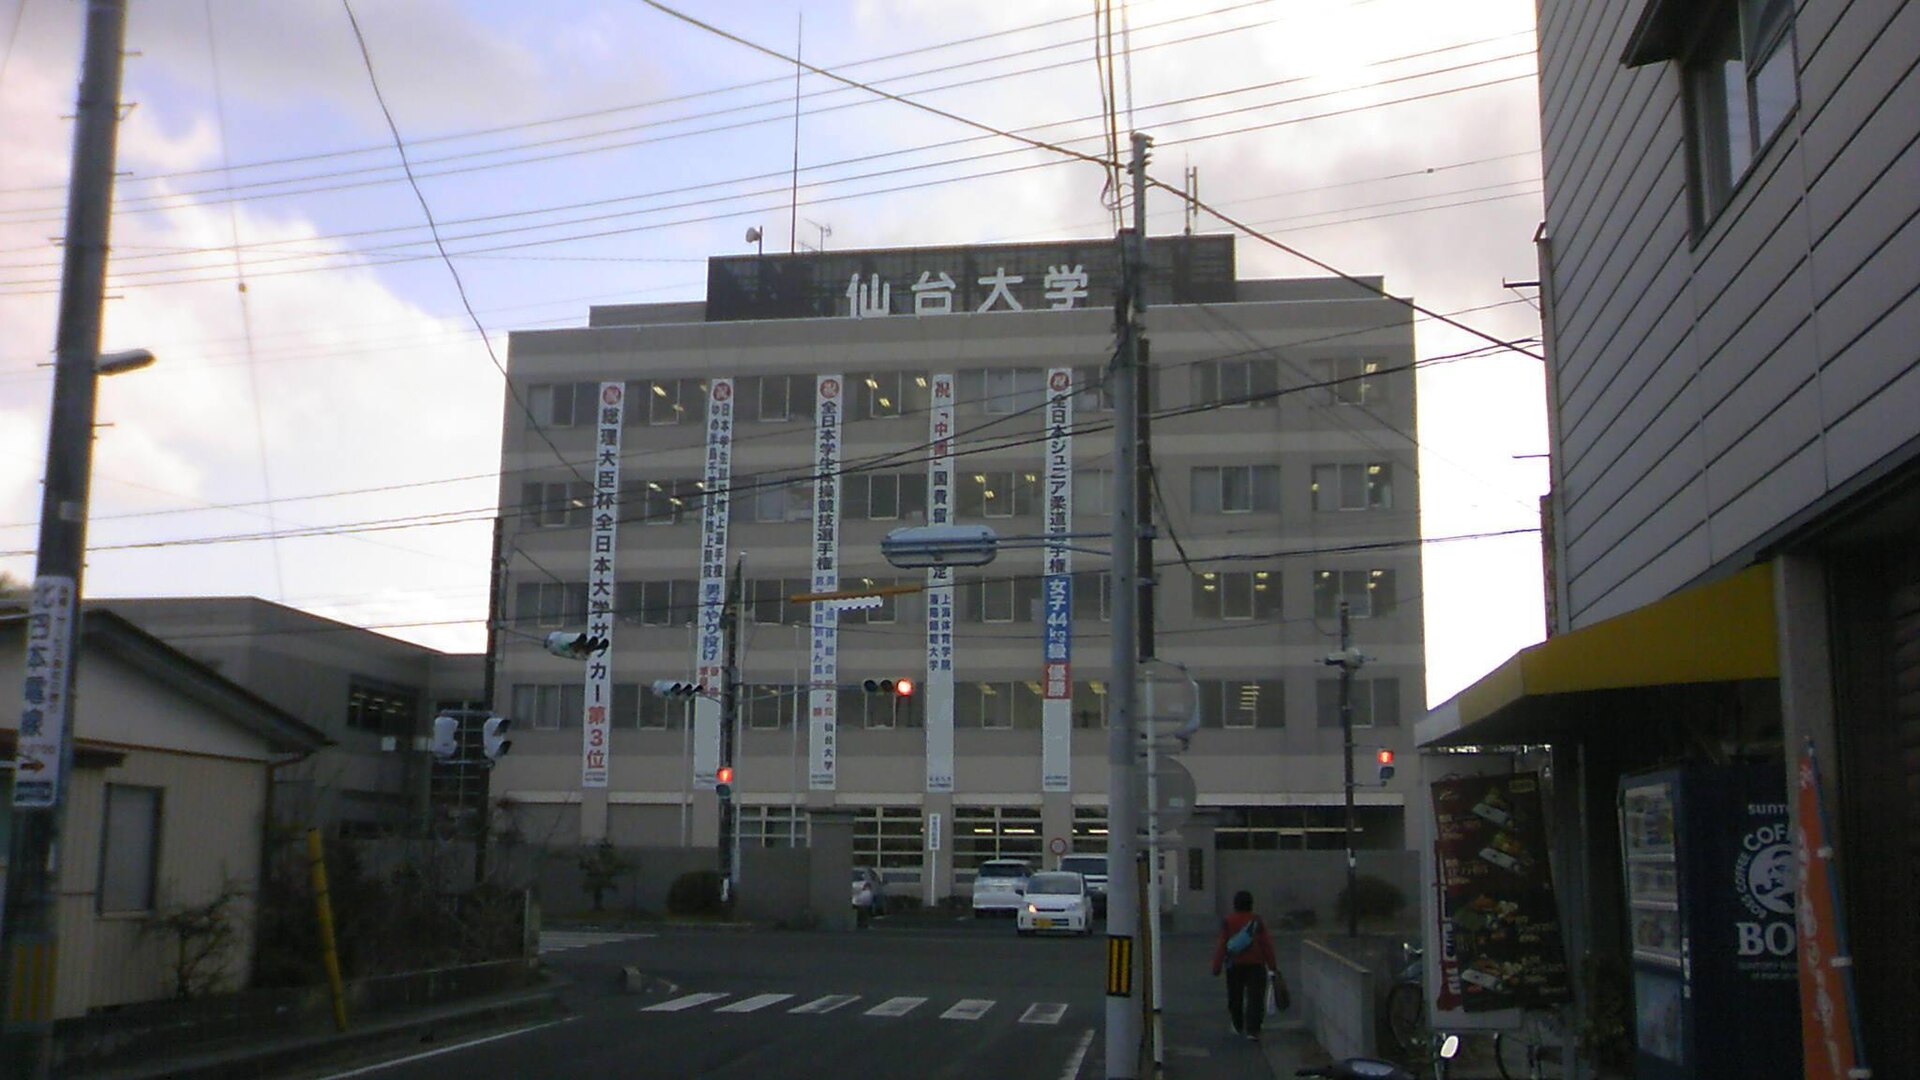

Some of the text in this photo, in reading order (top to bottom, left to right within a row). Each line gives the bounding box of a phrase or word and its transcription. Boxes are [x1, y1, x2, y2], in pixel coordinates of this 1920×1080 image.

[846, 264, 1088, 319] 仙台大学
[1748, 803, 1788, 815] SUNT
[1743, 823, 1788, 851] COF
[1737, 922, 1797, 955] BO
